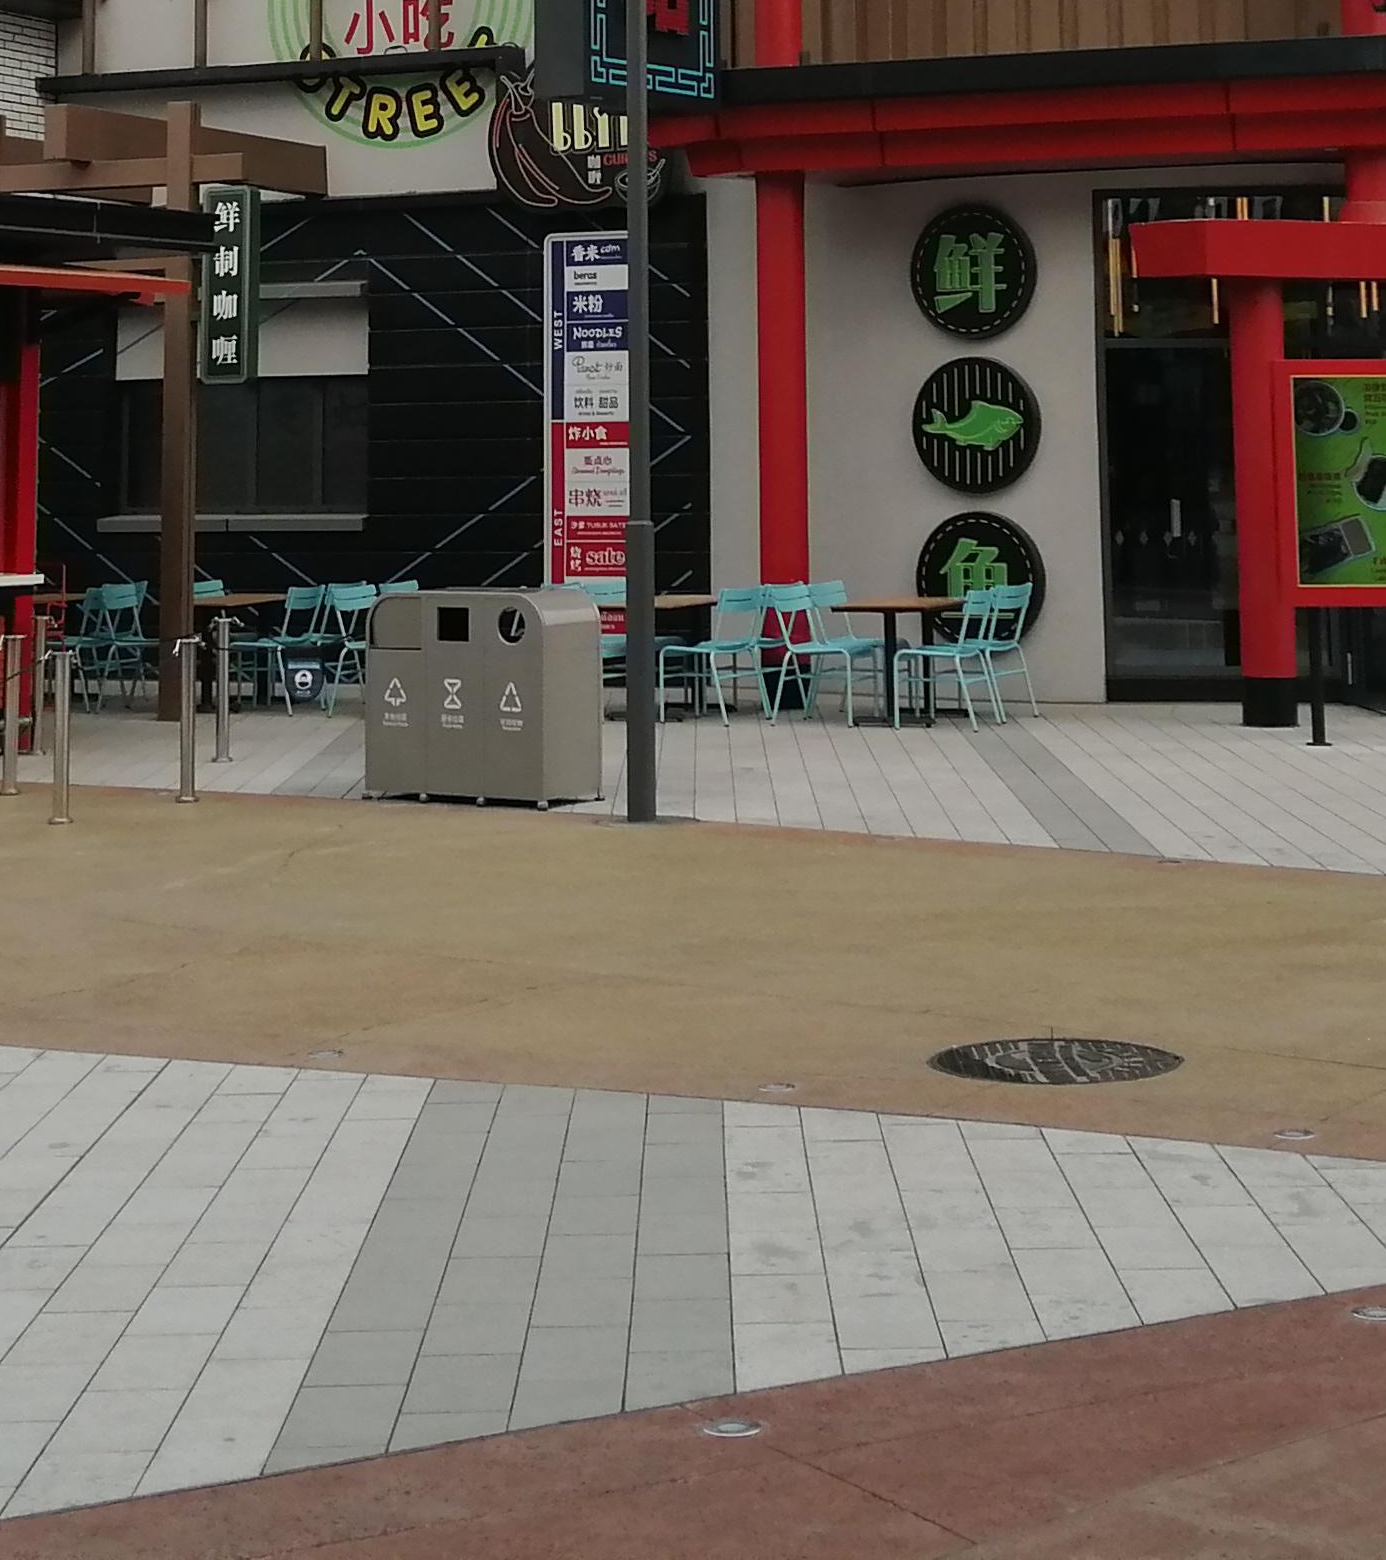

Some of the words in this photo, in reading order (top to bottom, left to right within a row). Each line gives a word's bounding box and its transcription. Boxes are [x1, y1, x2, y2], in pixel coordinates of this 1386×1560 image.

[211, 201, 241, 366] 鲜制咖喱
[572, 294, 604, 314] 米粉
[553, 310, 563, 350] WEST
[573, 326, 623, 340] NOODLES
[574, 396, 594, 409] 饮料
[568, 425, 608, 441] 炸小食
[553, 508, 563, 547] EAST
